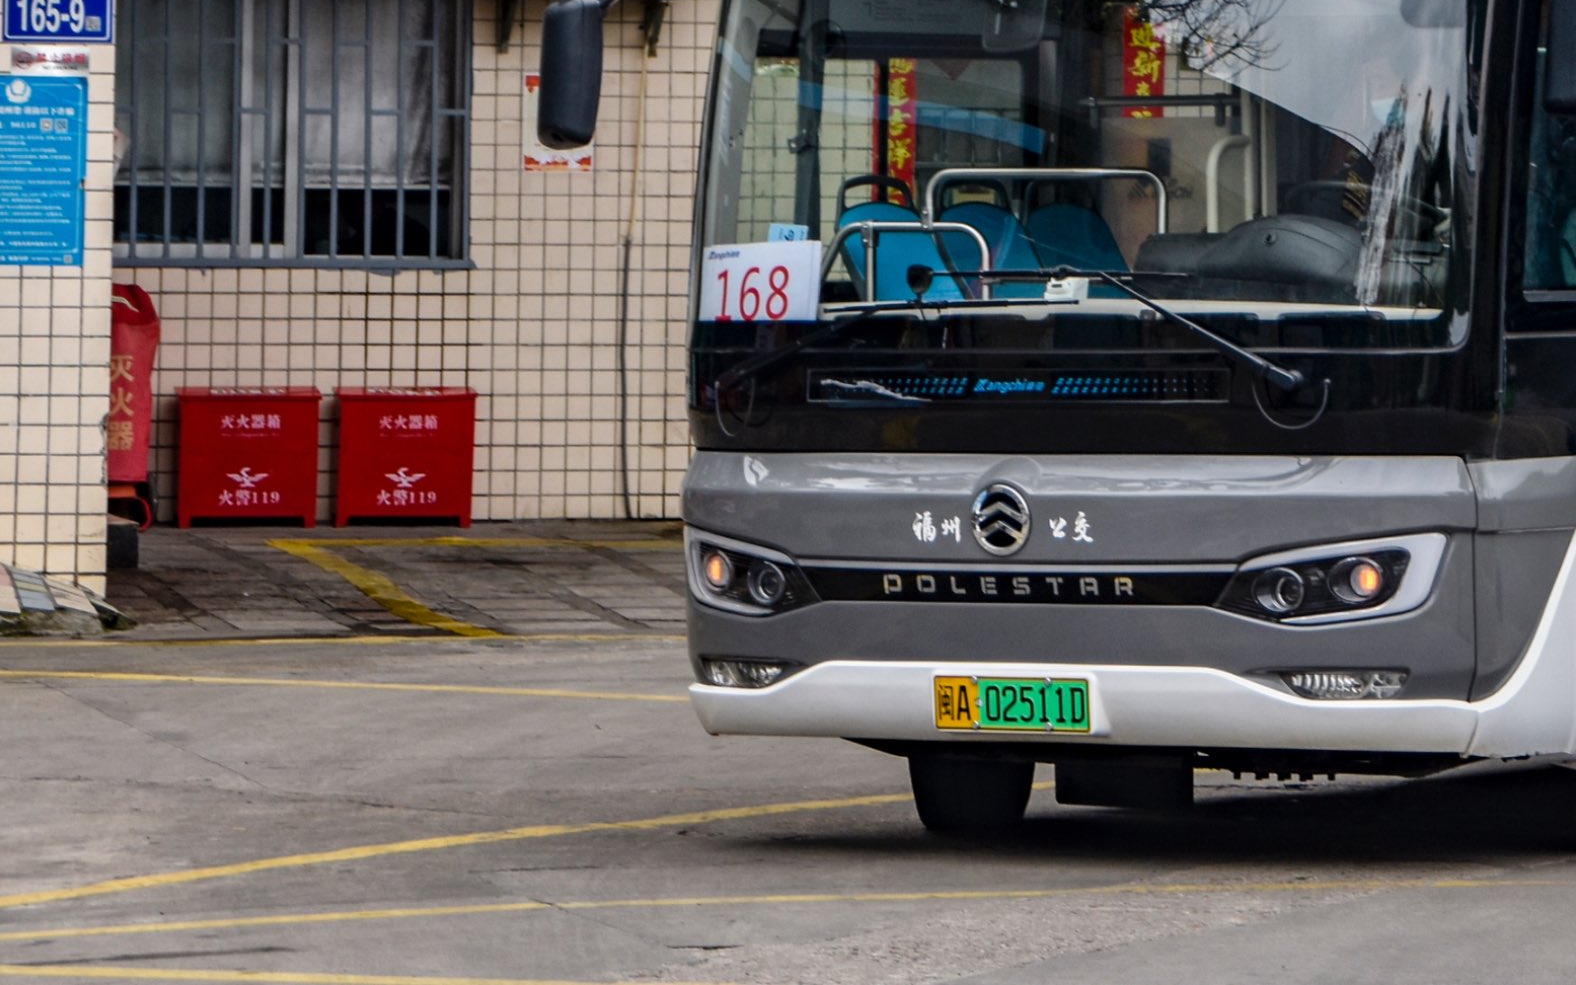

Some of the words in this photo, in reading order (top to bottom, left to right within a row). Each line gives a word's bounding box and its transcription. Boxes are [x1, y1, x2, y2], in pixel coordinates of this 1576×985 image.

[715, 265, 790, 323] 168
[221, 414, 281, 429] 灭火器箱
[379, 414, 438, 429] 灭火器箱
[912, 510, 961, 543] 福州
[1049, 511, 1094, 543] 公交
[883, 574, 1134, 596] POLESTAR
[985, 685, 1086, 724] 02511D
